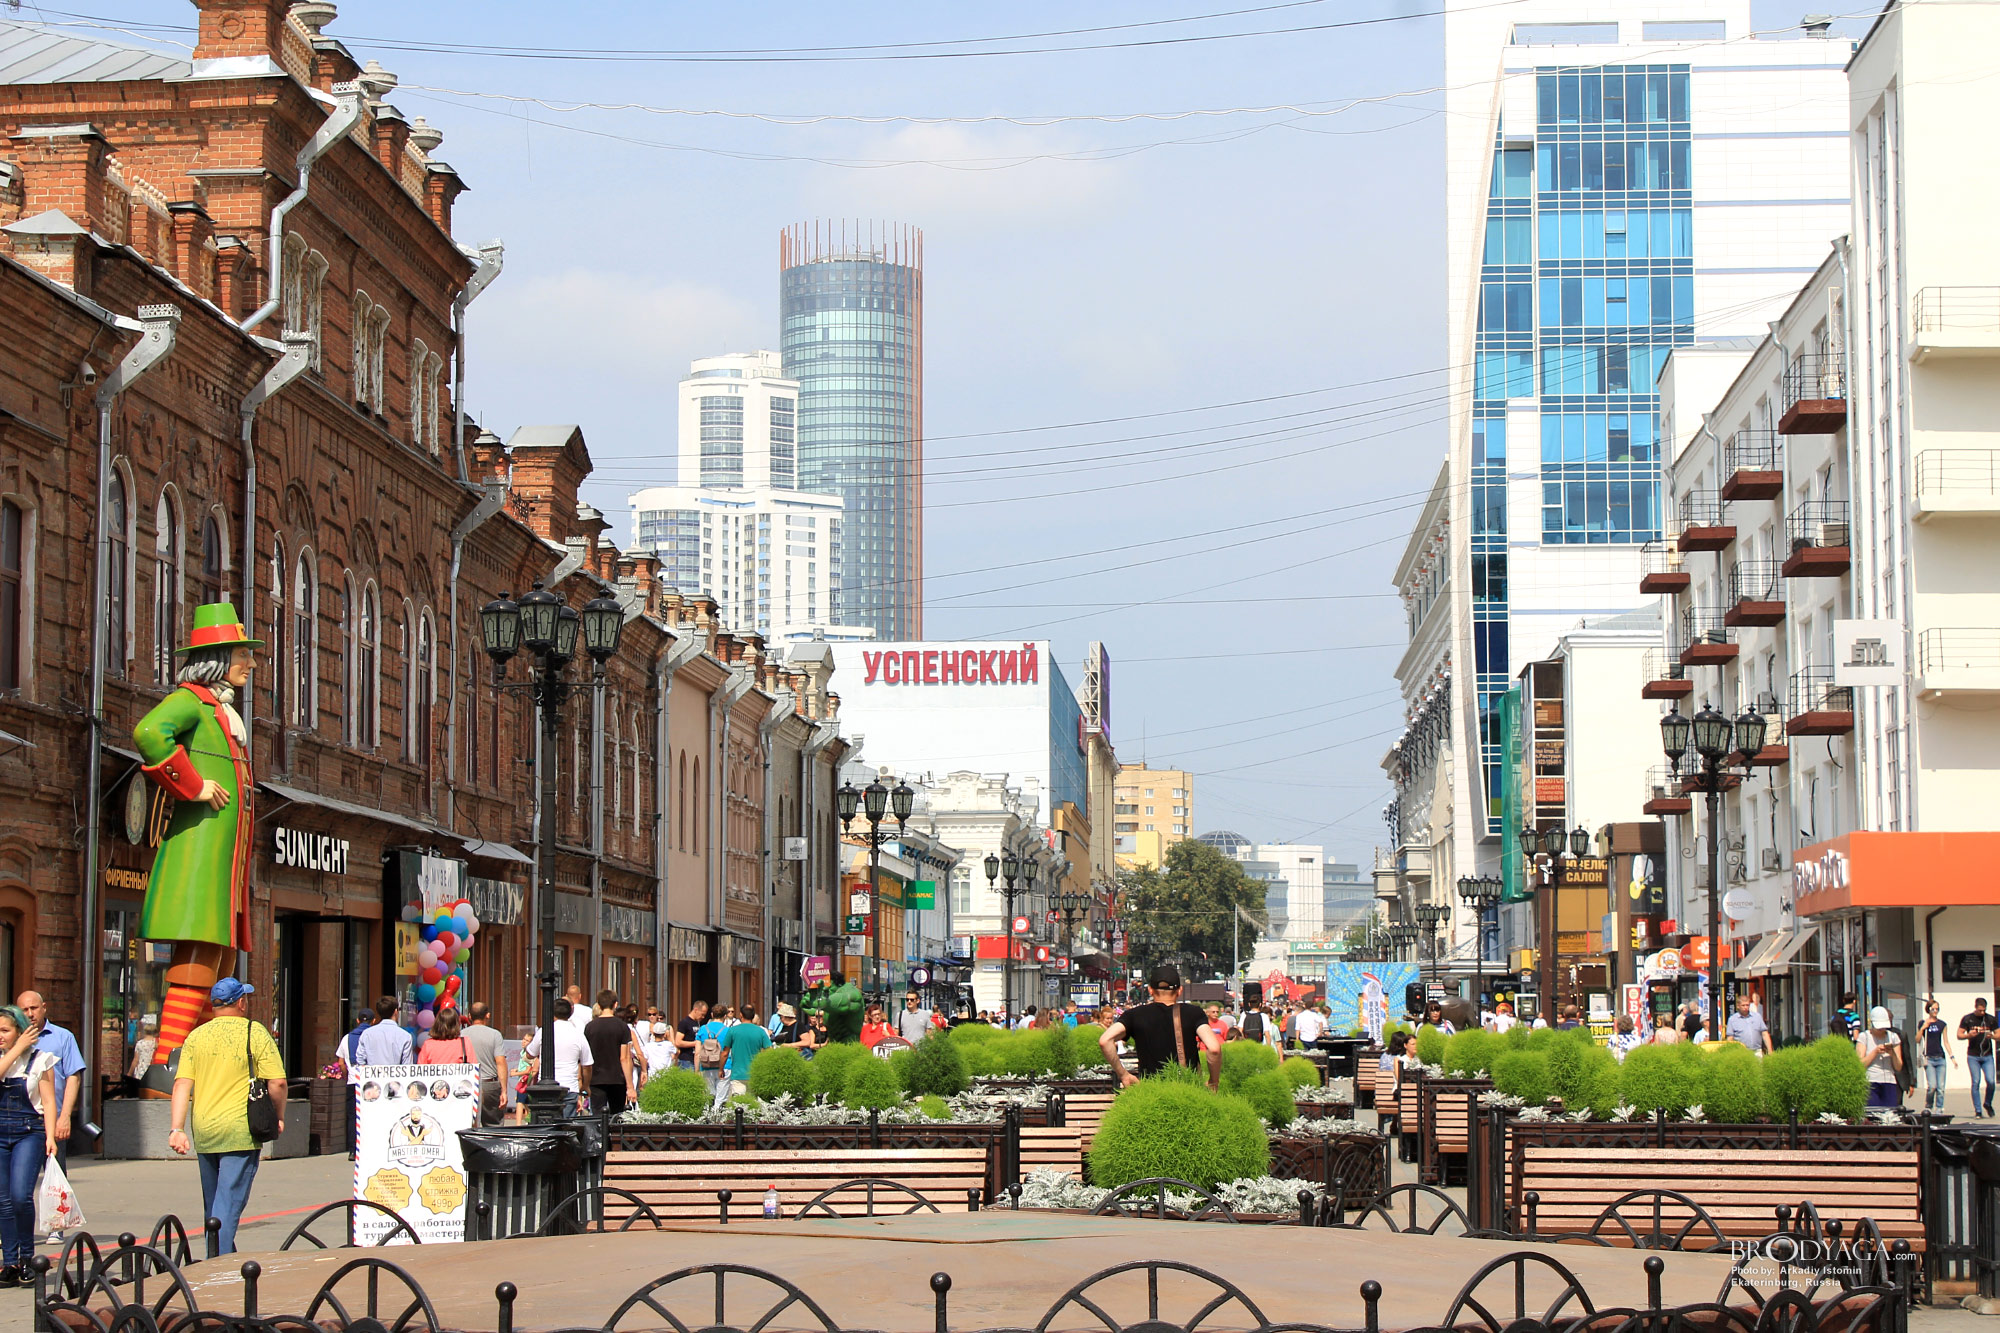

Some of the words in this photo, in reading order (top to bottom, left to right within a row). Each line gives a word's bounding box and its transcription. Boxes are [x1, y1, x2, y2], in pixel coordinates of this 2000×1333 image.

[1851, 638, 1887, 663] БТИ
[863, 642, 1039, 683] УСПЕНСКИЙ
[275, 826, 350, 874] SUNLIGHT
[1566, 872, 1603, 883] САЛОН
[364, 1066, 408, 1079] EXPRESS
[409, 1064, 474, 1078] BARBERSHOP
[421, 1146, 440, 1156] OMER
[429, 1174, 456, 1183] любая
[425, 1187, 459, 1196] стрижка
[431, 1199, 453, 1208] 499р
